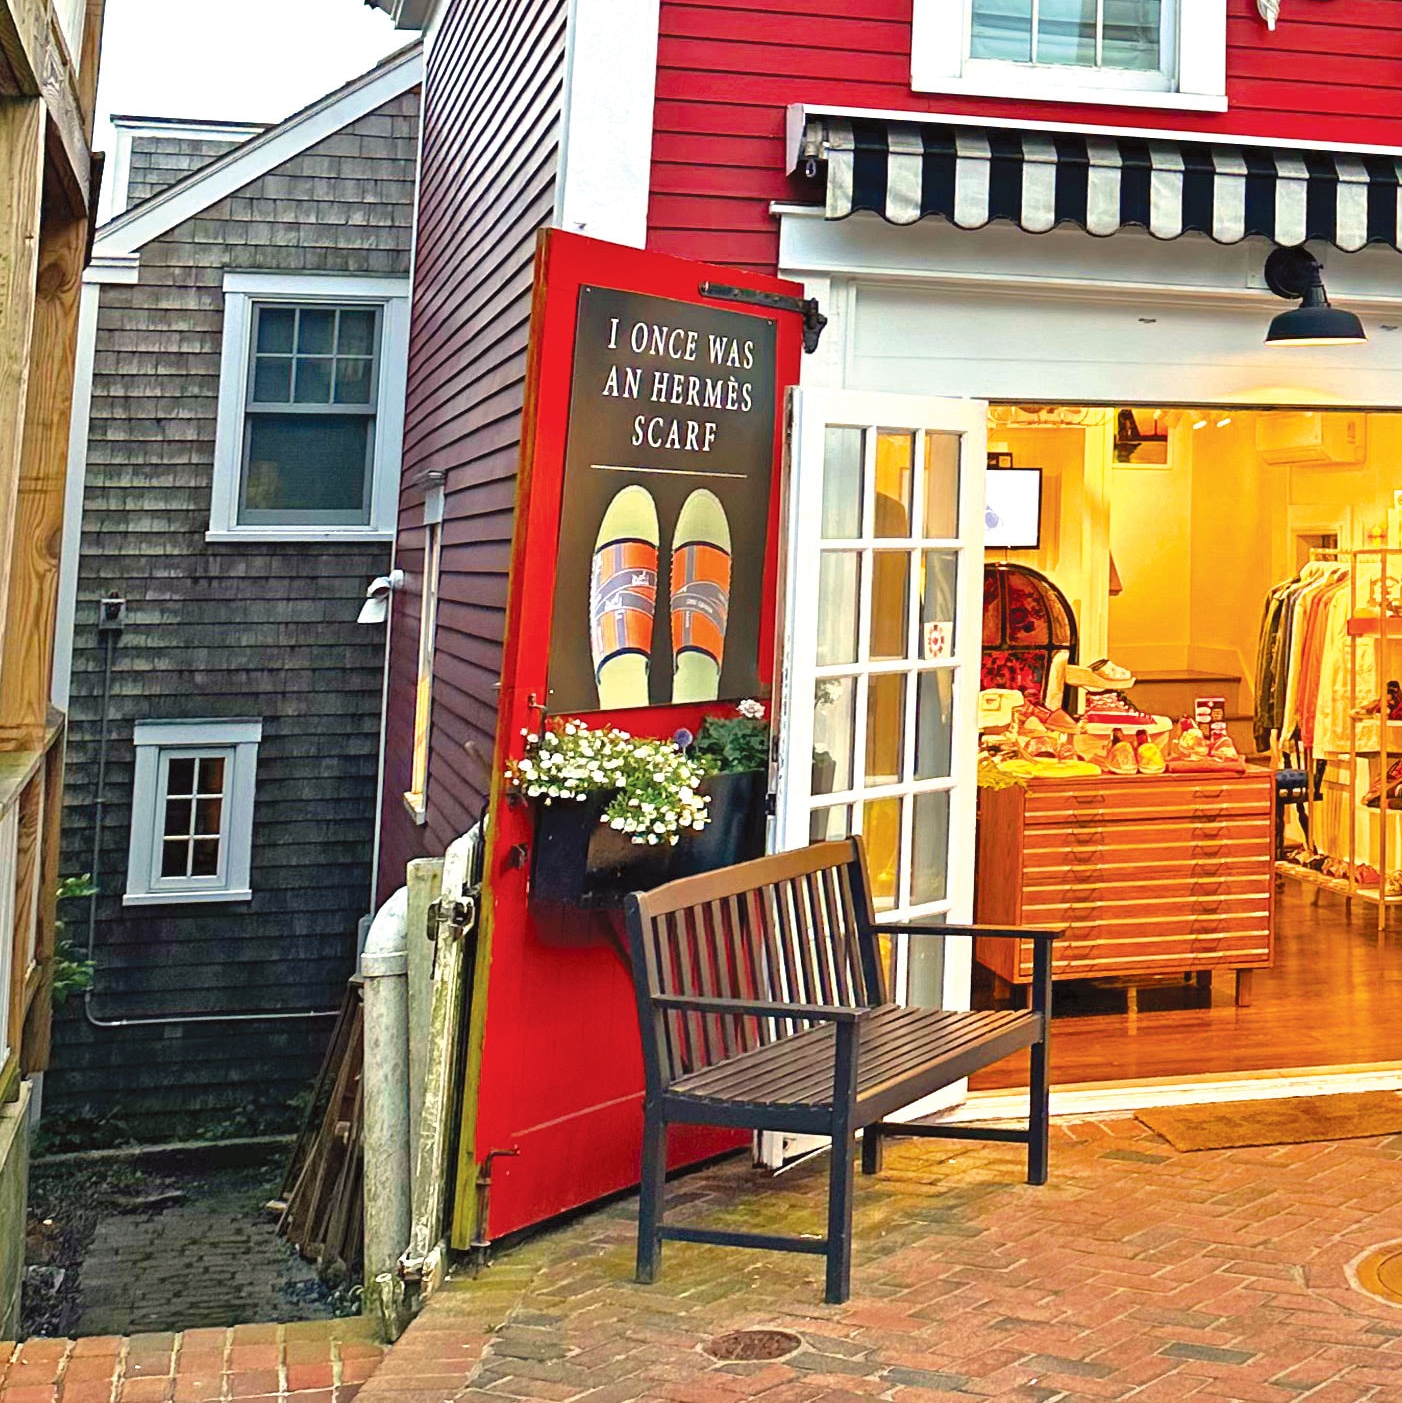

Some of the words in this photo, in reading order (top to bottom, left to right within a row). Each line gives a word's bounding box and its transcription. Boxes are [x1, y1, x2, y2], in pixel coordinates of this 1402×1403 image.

[607, 318, 620, 349] I
[631, 322, 698, 361] ONCE
[708, 334, 754, 370] WAS
[602, 365, 643, 399] AN
[650, 371, 753, 412] HERMÈS
[631, 415, 717, 452] SCARF
